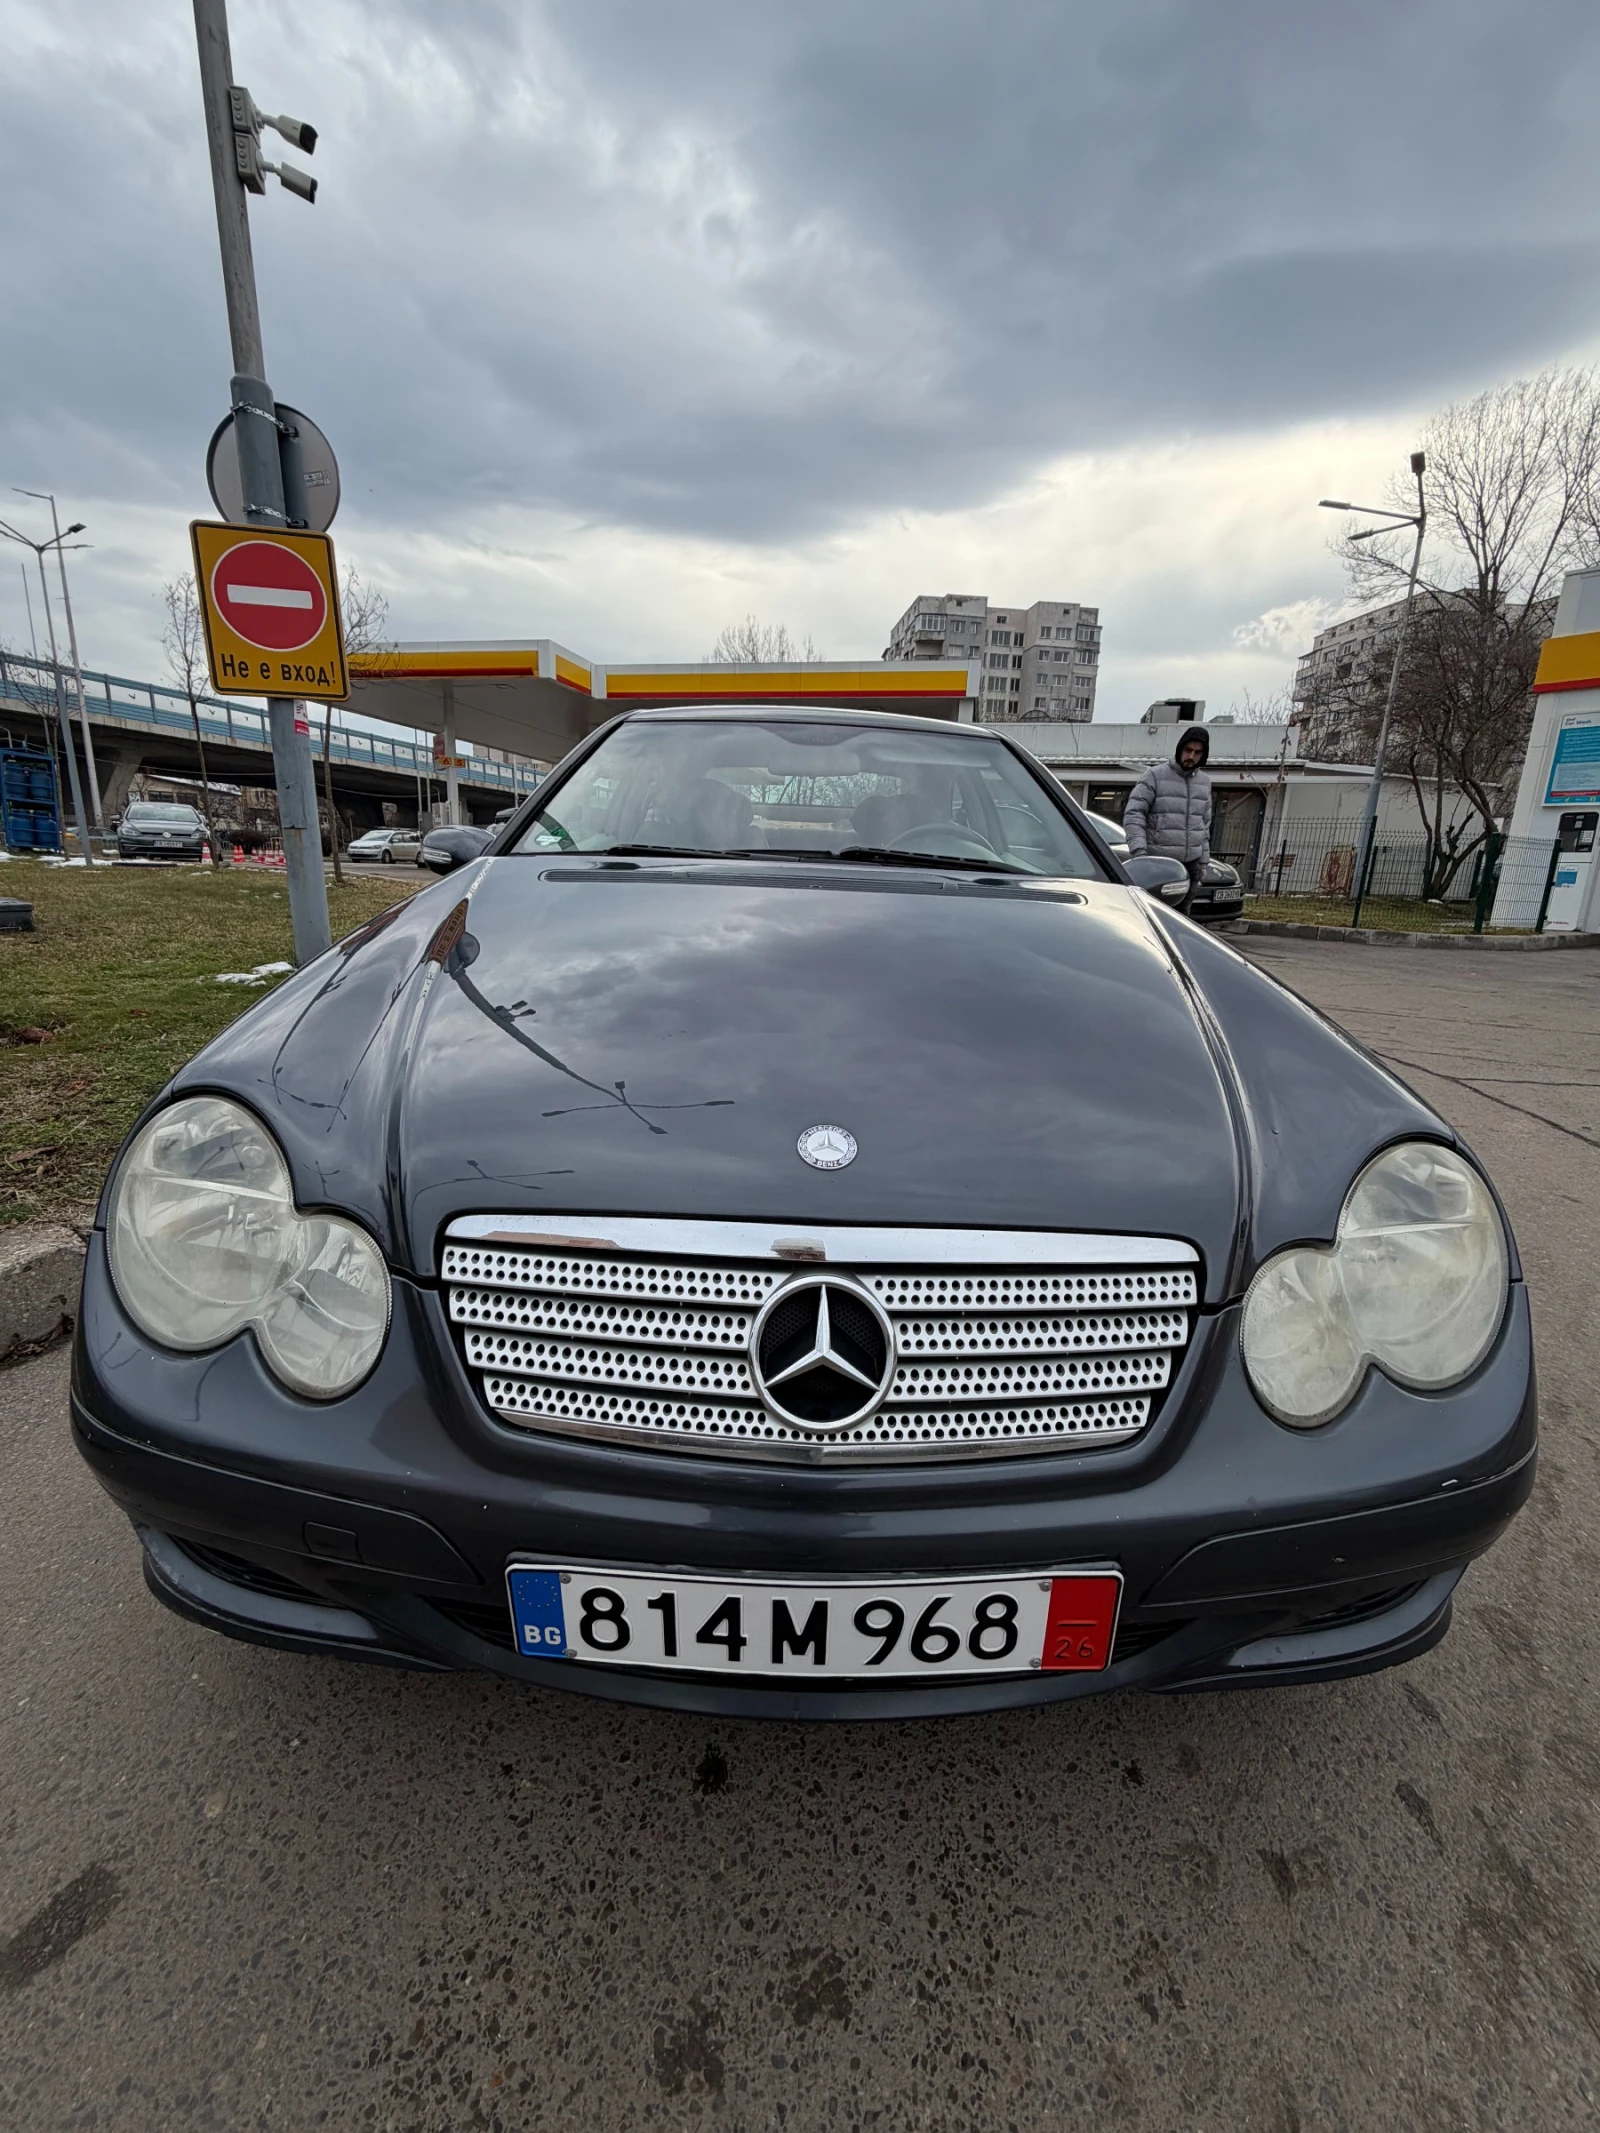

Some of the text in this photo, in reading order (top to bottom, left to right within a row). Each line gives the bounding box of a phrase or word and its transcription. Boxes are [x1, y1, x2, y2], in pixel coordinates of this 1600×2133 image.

[220, 653, 336, 687] Не е вход!
[523, 1624, 562, 1646] BG
[1054, 1636, 1095, 1659] 26
